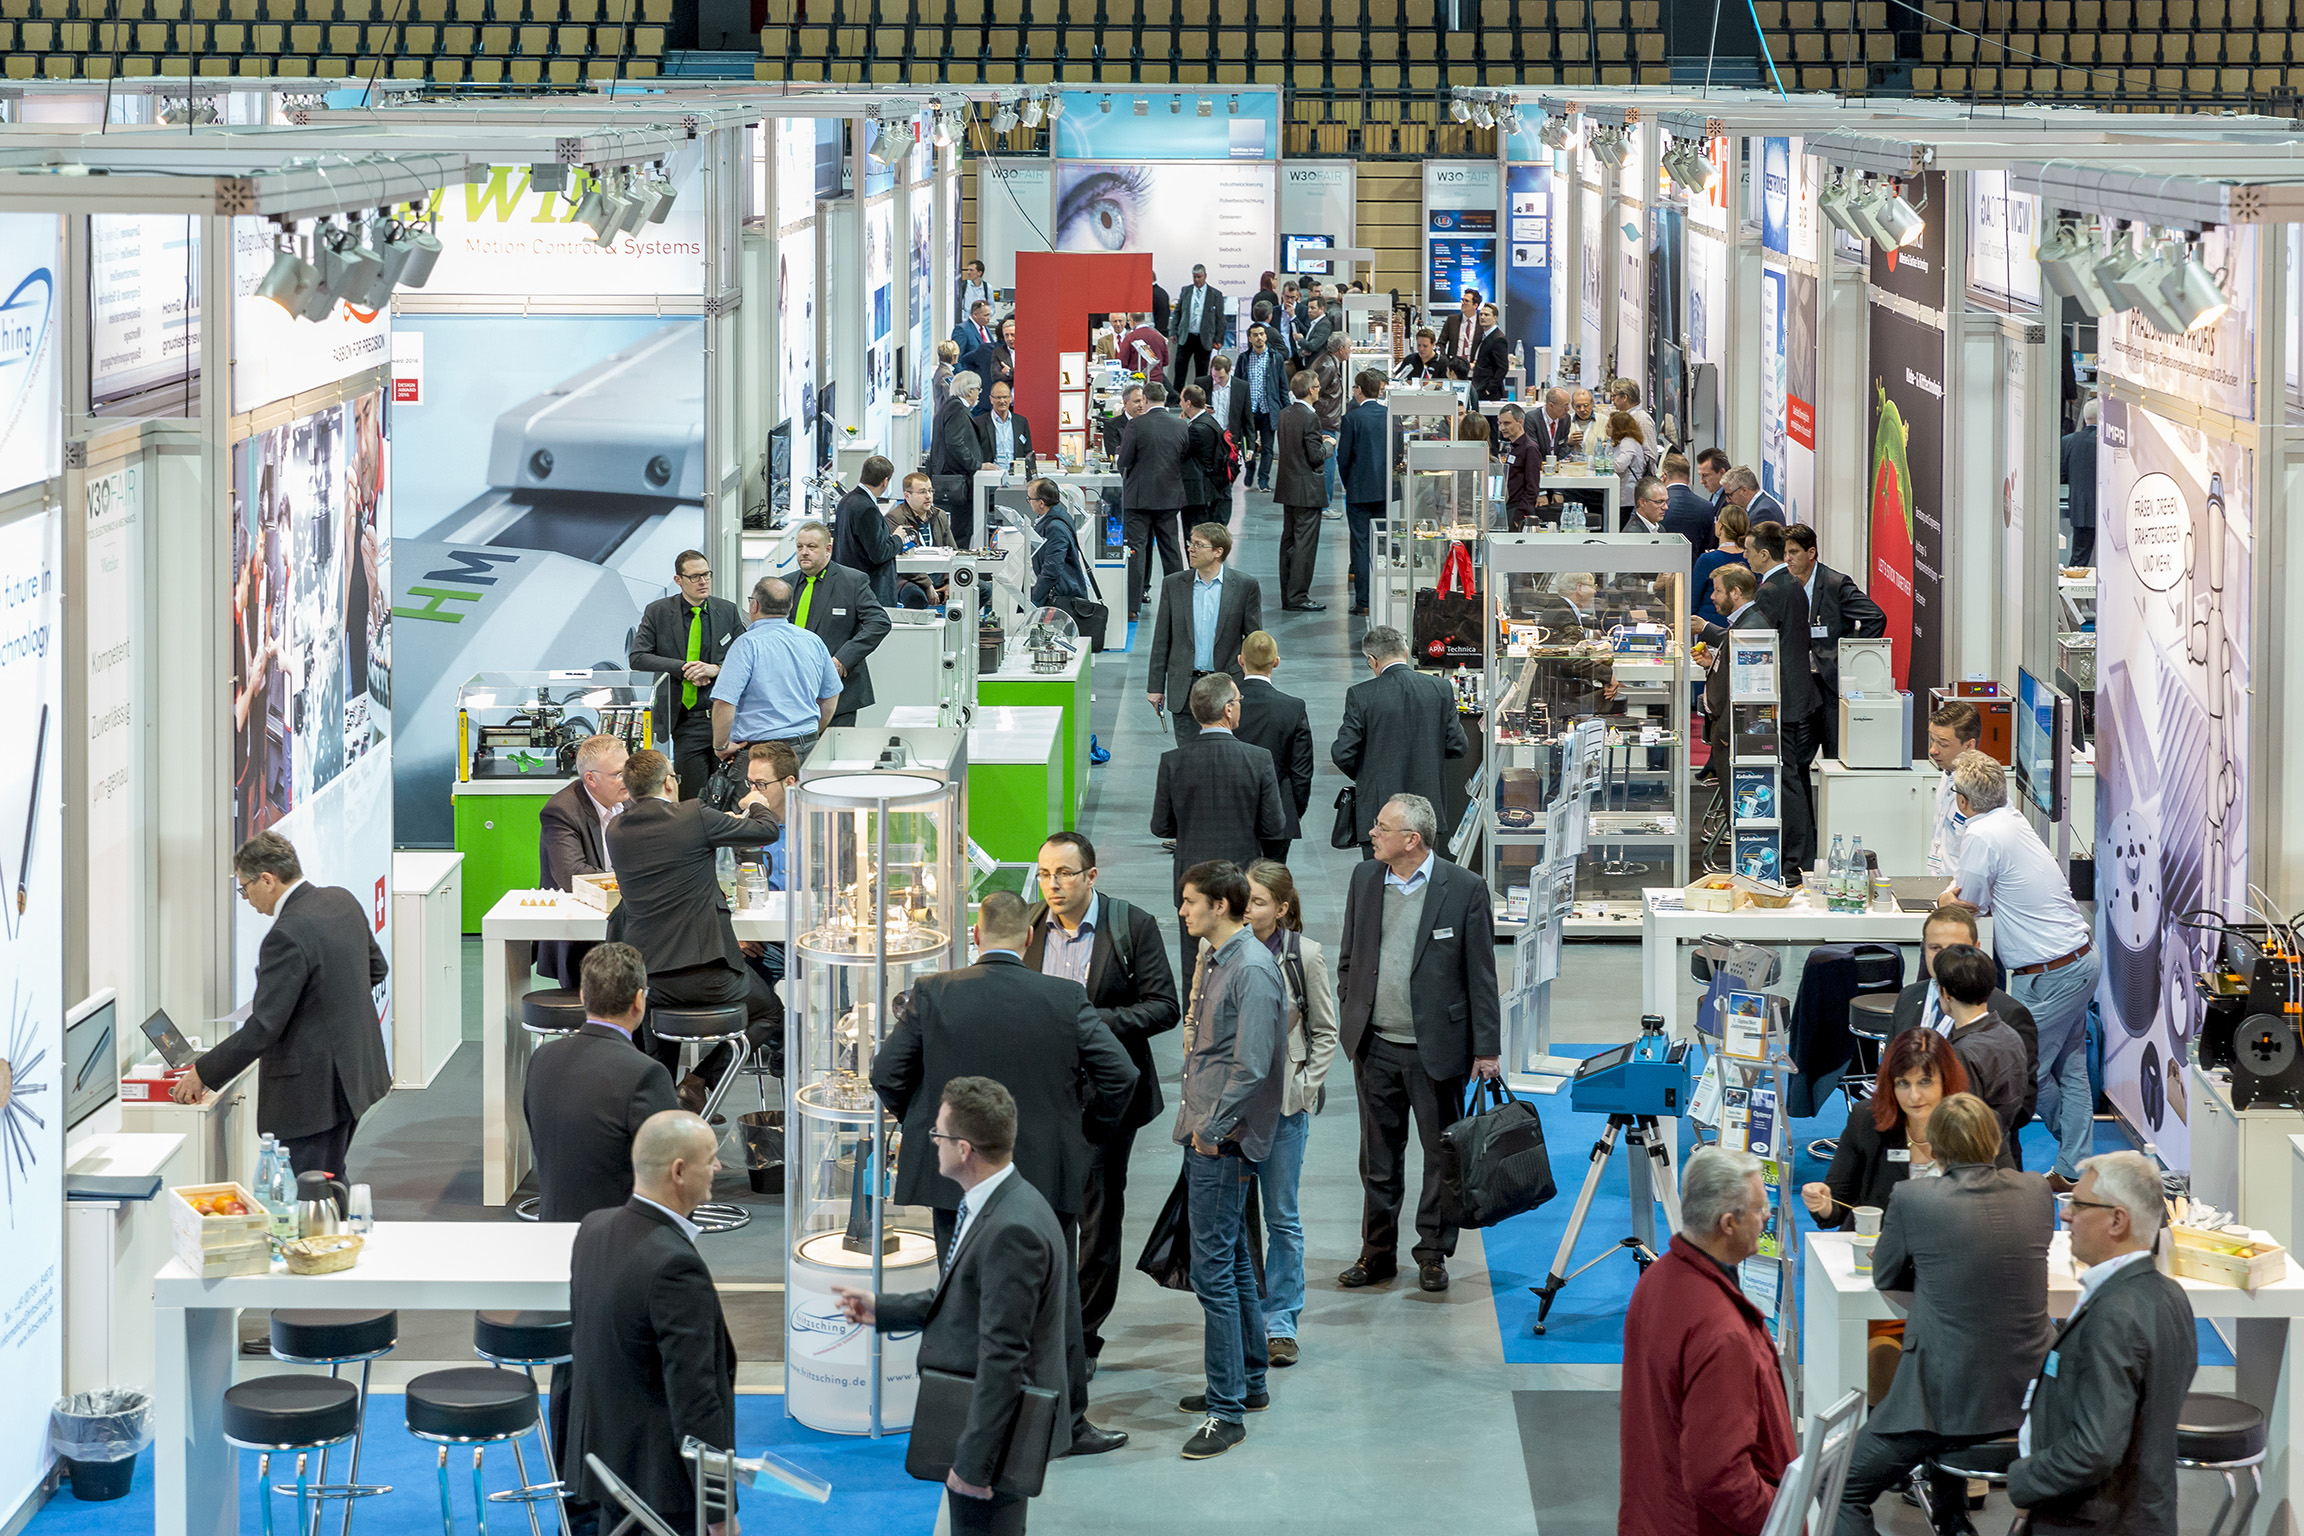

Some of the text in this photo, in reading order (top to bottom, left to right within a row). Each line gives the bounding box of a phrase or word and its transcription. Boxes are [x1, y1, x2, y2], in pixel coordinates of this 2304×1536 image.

[466, 238, 701, 258] Motion Control & Systems
[2105, 422, 2126, 445] IMPA
[5, 572, 38, 608] future
[92, 636, 130, 675] Kompetent
[796, 1313, 846, 1335] fritzsching
[790, 1362, 866, 1388] www.fritzsching.de
